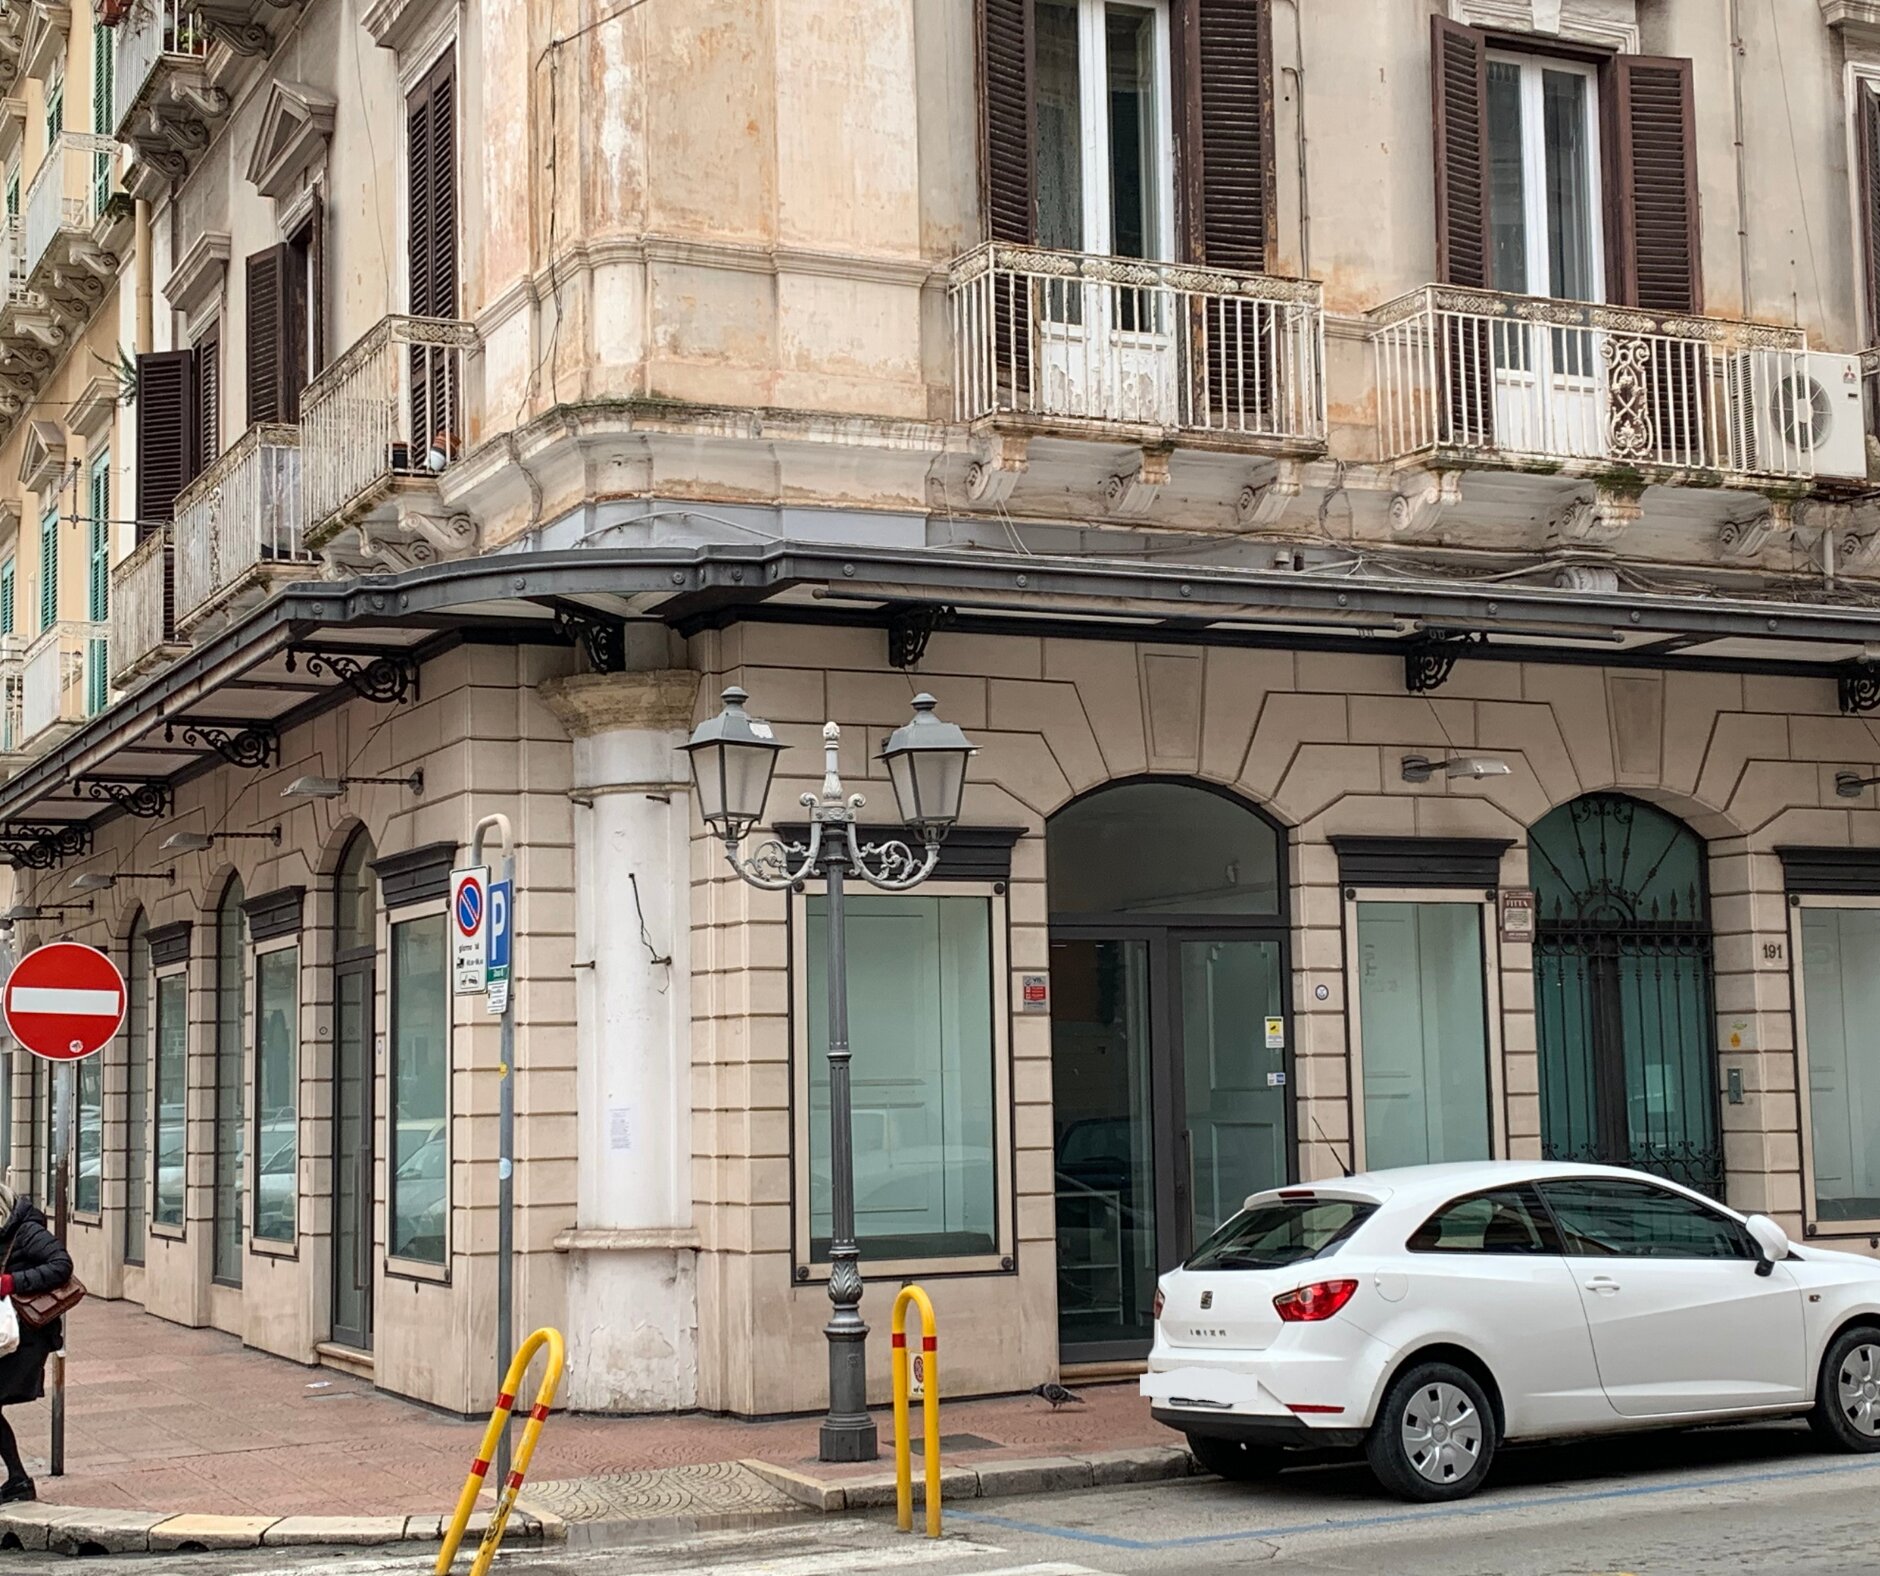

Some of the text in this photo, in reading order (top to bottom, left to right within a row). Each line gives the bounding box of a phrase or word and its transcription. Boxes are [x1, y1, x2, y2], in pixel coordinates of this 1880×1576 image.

[491, 890, 506, 961] P
[1762, 944, 1782, 959] 191
[1189, 1328, 1227, 1337] IBIZA
